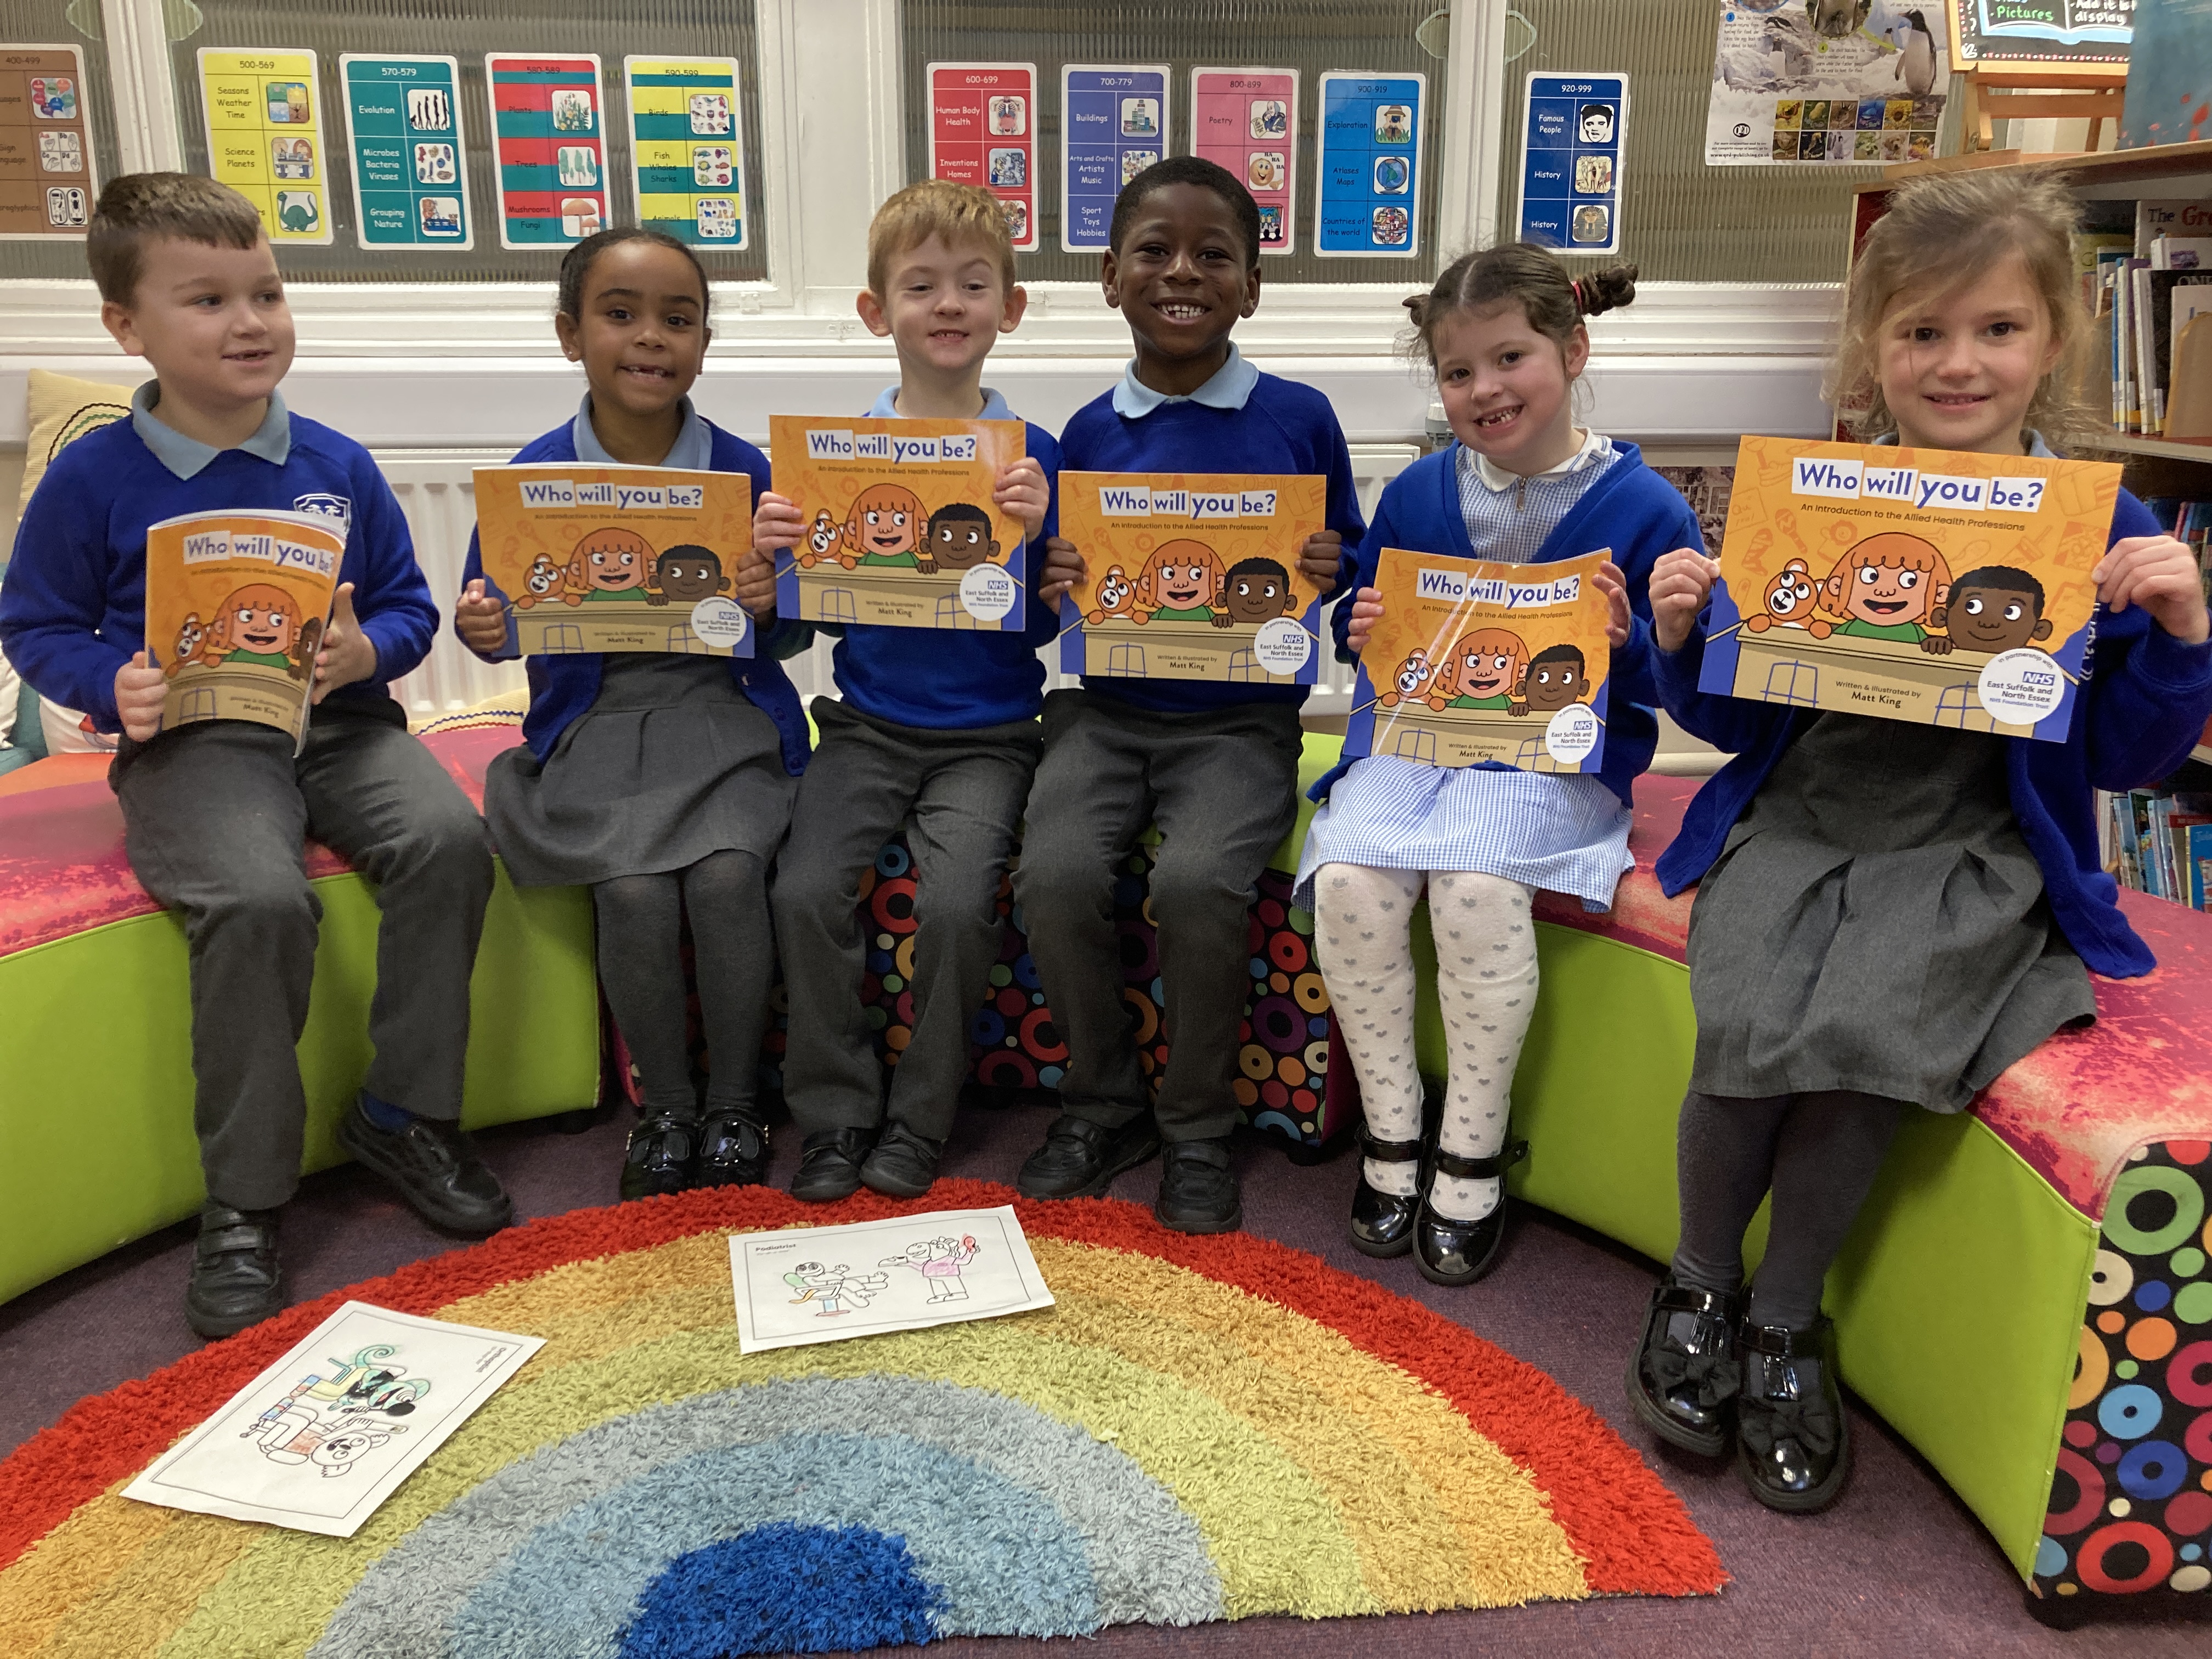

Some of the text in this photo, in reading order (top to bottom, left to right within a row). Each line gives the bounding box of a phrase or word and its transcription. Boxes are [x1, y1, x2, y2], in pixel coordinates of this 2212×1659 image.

[1997, 5, 2053, 21] Pictures
[2075, 11, 2126, 26] display
[382, 67, 416, 76] 570-579
[359, 105, 395, 114] Evolution
[509, 106, 532, 114] Plants
[963, 106, 980, 116] Body
[1076, 114, 1108, 123] Buildings
[1209, 116, 1233, 126] Poetry
[1538, 114, 1564, 122] Famous
[1328, 120, 1368, 129] Exploration
[1539, 126, 1561, 135] People
[1735, 125, 1749, 135] QED
[363, 149, 399, 157] Microbes
[366, 160, 400, 168] Bacteria
[369, 172, 398, 180] Viruses
[1534, 171, 1561, 180] History
[1336, 178, 1355, 187] Maps
[370, 208, 404, 218] Grouping
[1081, 207, 1102, 215] Sport
[2148, 207, 2175, 223] The
[374, 220, 403, 228] Nature
[521, 222, 540, 230] Fungi
[1083, 218, 1100, 227] Toys
[1531, 221, 1558, 230] History
[811, 434, 975, 464] Who will you be?
[1799, 463, 2044, 509] Who will you be?
[525, 485, 702, 511] Who will you be?
[1104, 491, 1276, 520] Who will you be?
[1801, 504, 2025, 532] An Introduction to the Allied Health Professions
[188, 537, 228, 557] Who
[235, 537, 269, 555] will
[277, 545, 316, 566] you
[988, 581, 1008, 589] NHS
[1423, 573, 1579, 610] Who will you be?
[896, 608, 912, 618] King
[1189, 662, 1205, 672] King
[2024, 673, 2054, 685] NHS
[1836, 680, 1862, 690] Written
[1871, 685, 1909, 696] Illustrated
[1987, 681, 2052, 695] East Suffolk and
[1851, 691, 1901, 709] Matt King
[2002, 691, 2051, 703] North Essex
[2002, 699, 2033, 708] Foundation
[1575, 721, 1592, 730] NHS
[1478, 751, 1493, 760] King
